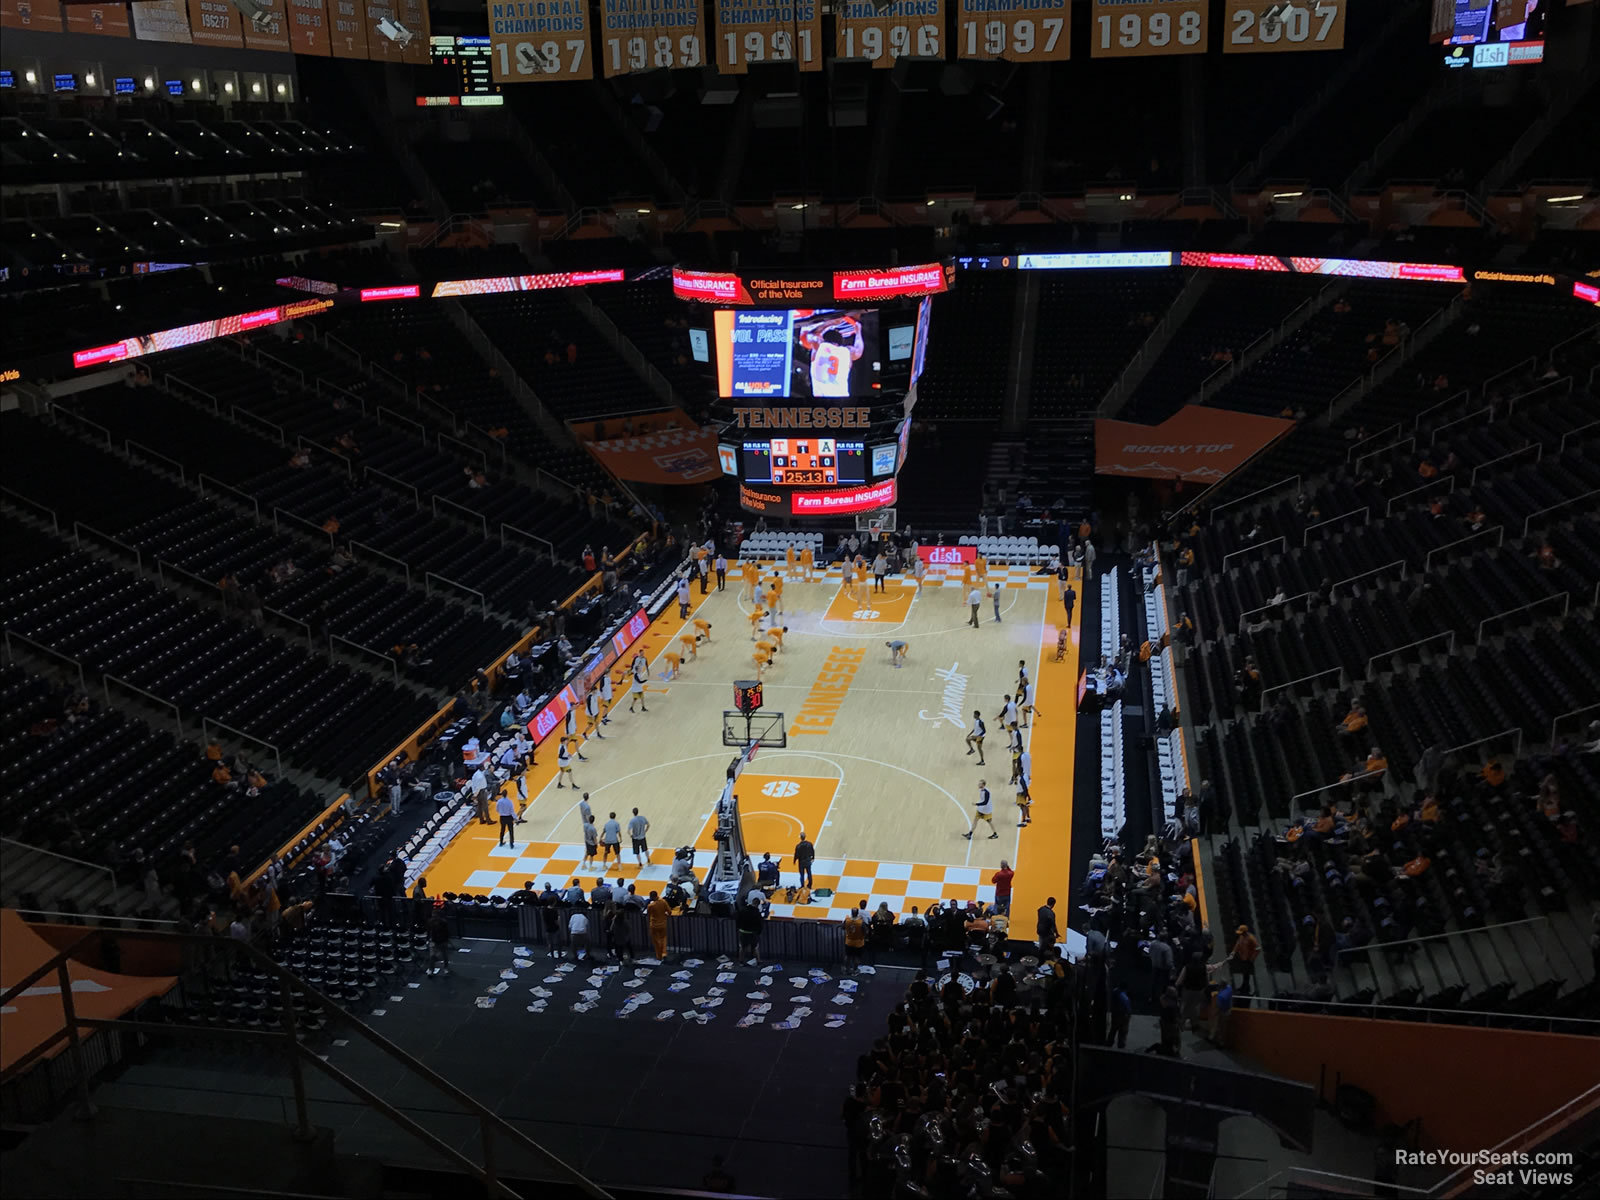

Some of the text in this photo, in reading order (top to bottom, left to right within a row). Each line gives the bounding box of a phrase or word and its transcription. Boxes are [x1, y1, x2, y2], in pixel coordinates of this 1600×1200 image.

[493, 0, 583, 17] NATIONAL
[720, 7, 815, 24] CHAMPIONS
[495, 17, 584, 33] CHAMPIONS
[607, 12, 698, 28] CHAMPIONS
[1232, 6, 1338, 45] 2007
[963, 18, 1064, 55] 1997
[1097, 11, 1201, 48] 1998
[724, 29, 812, 65] 1991
[842, 25, 939, 60] 1996
[496, 40, 585, 76] 1987
[607, 34, 700, 70] 1989
[1475, 47, 1505, 63] dish
[1002, 257, 1010, 267] 0
[1023, 256, 1033, 268] A
[693, 279, 735, 290] INSURANCE
[750, 280, 824, 289] Official Insurance
[841, 279, 866, 289] Farm
[868, 277, 899, 287] Bureau
[900, 270, 940, 284] INSURANCE
[758, 290, 803, 299] of the Vols
[738, 314, 784, 325] Introducing
[731, 329, 790, 343] VOL PASS
[733, 407, 871, 428] TENNESSEE
[774, 441, 784, 452] T
[822, 441, 832, 452] A
[1122, 443, 1235, 454] ROCKY TOP
[720, 449, 733, 471] T
[777, 457, 784, 465] 0
[824, 457, 830, 465] 0
[787, 472, 822, 483] 25:13
[798, 485, 892, 506] Farm Bureau INSURANCE
[929, 547, 962, 563] dish
[788, 645, 867, 737] TENNESSEE
[750, 693, 761, 709] 30
[537, 708, 557, 737] dish
[761, 781, 801, 798] SEC
